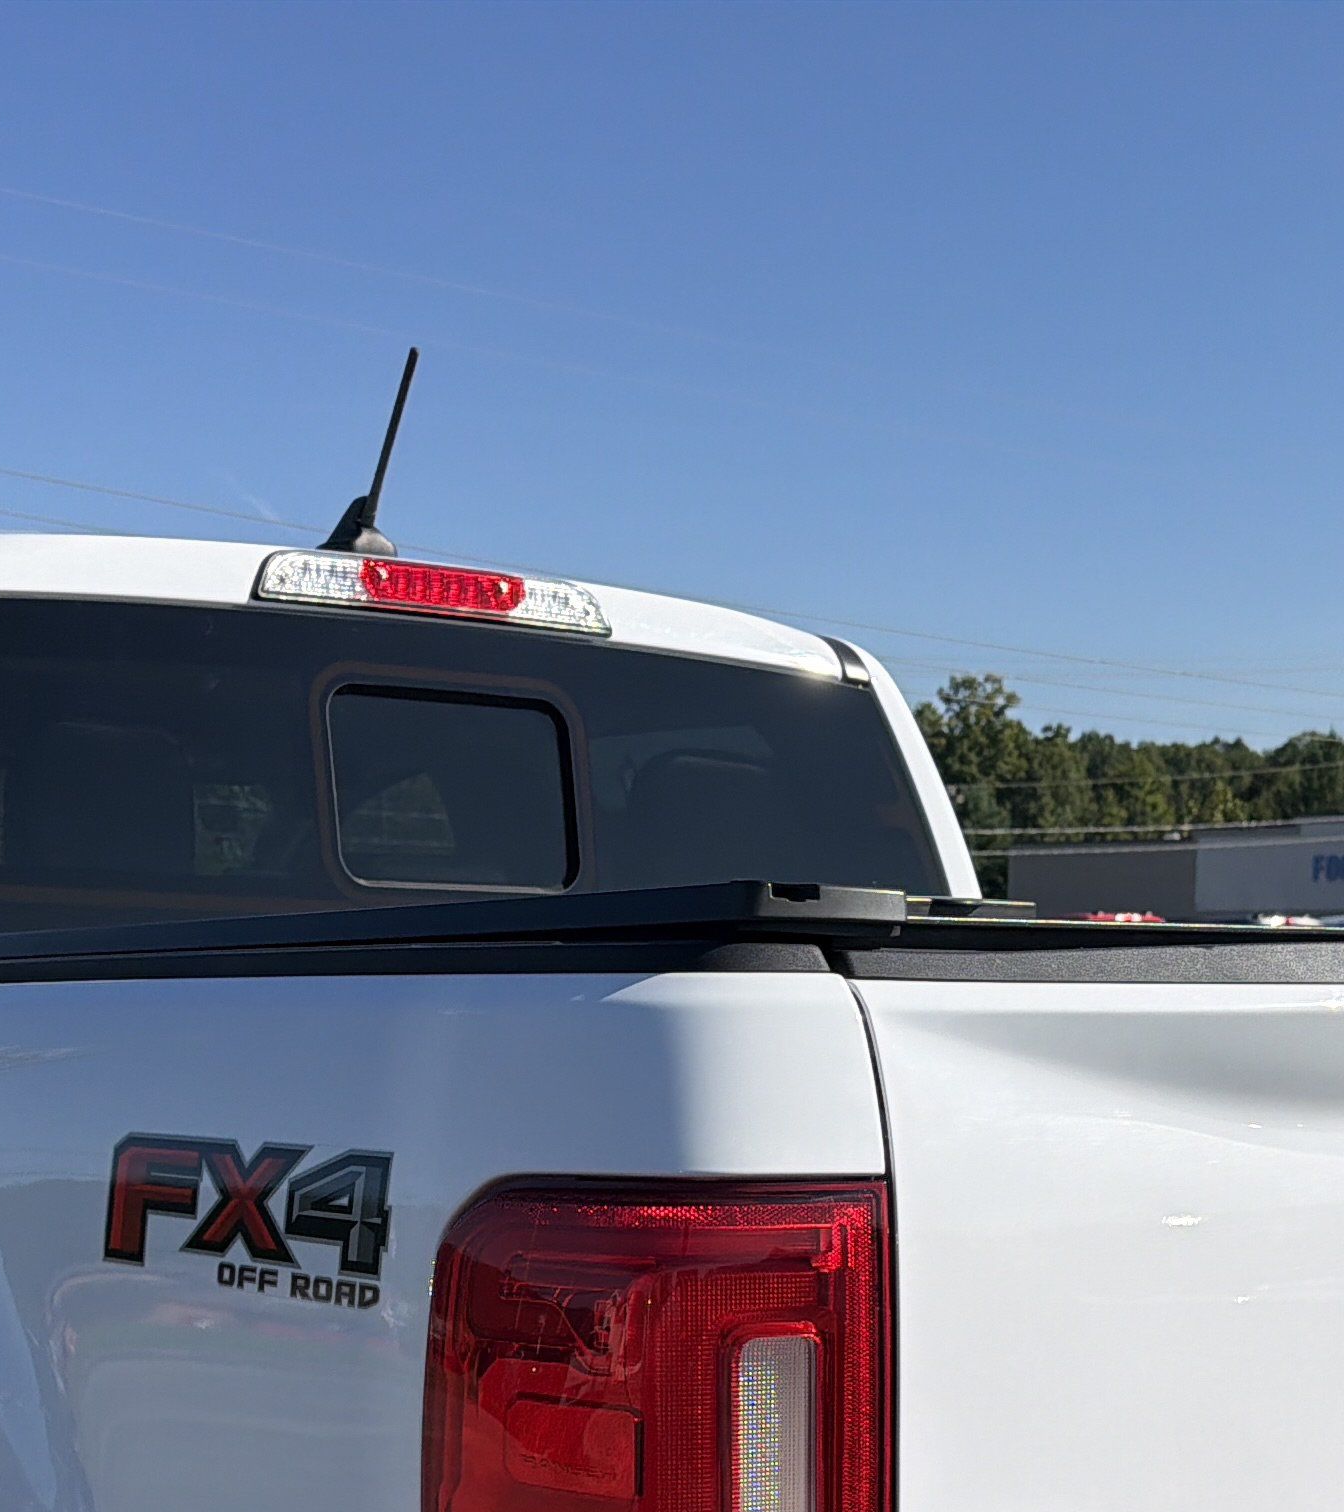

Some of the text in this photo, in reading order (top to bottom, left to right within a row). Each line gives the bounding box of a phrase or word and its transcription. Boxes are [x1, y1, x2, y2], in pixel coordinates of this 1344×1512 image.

[103, 1131, 395, 1281] FX4
[216, 1260, 381, 1309] OFF ROAD
